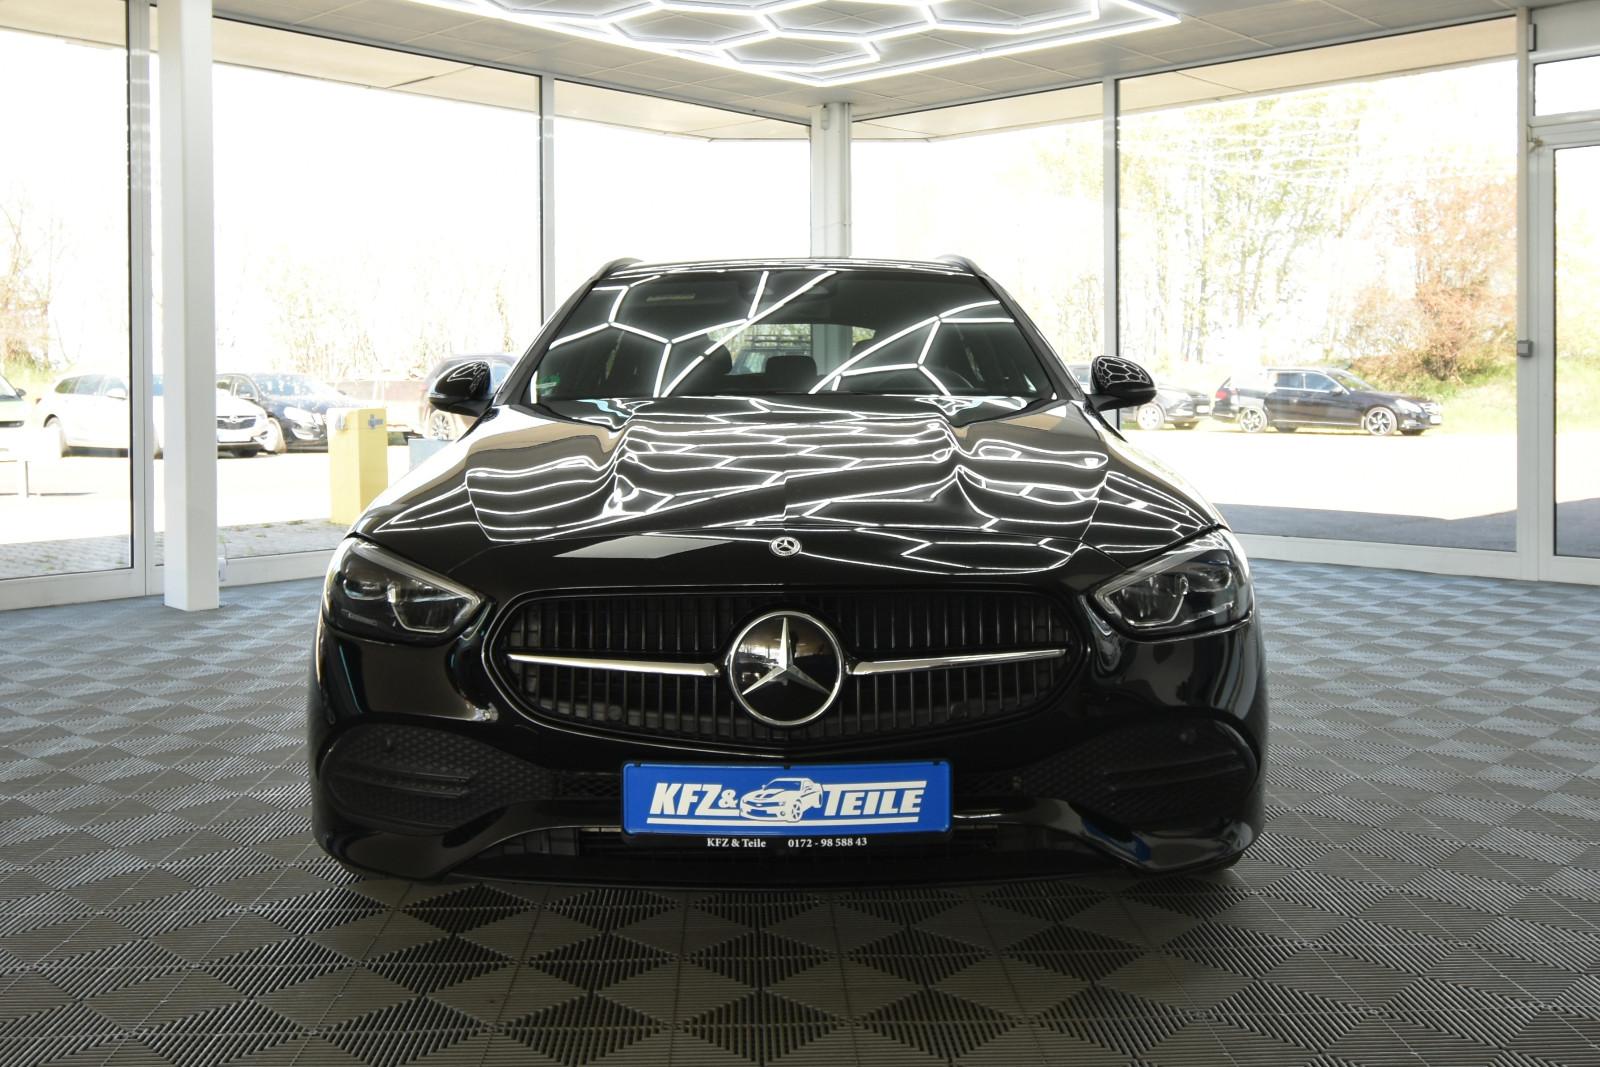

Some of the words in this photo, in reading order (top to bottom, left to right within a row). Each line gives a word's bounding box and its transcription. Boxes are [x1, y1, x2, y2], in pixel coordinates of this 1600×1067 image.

[822, 781, 928, 817] TEILE
[706, 838, 730, 848] KFZ
[731, 838, 740, 848] &
[741, 838, 767, 848] Teile
[787, 838, 813, 848] 0172
[820, 838, 833, 847] 98
[835, 838, 854, 847] 588
[855, 837, 868, 847] 43
